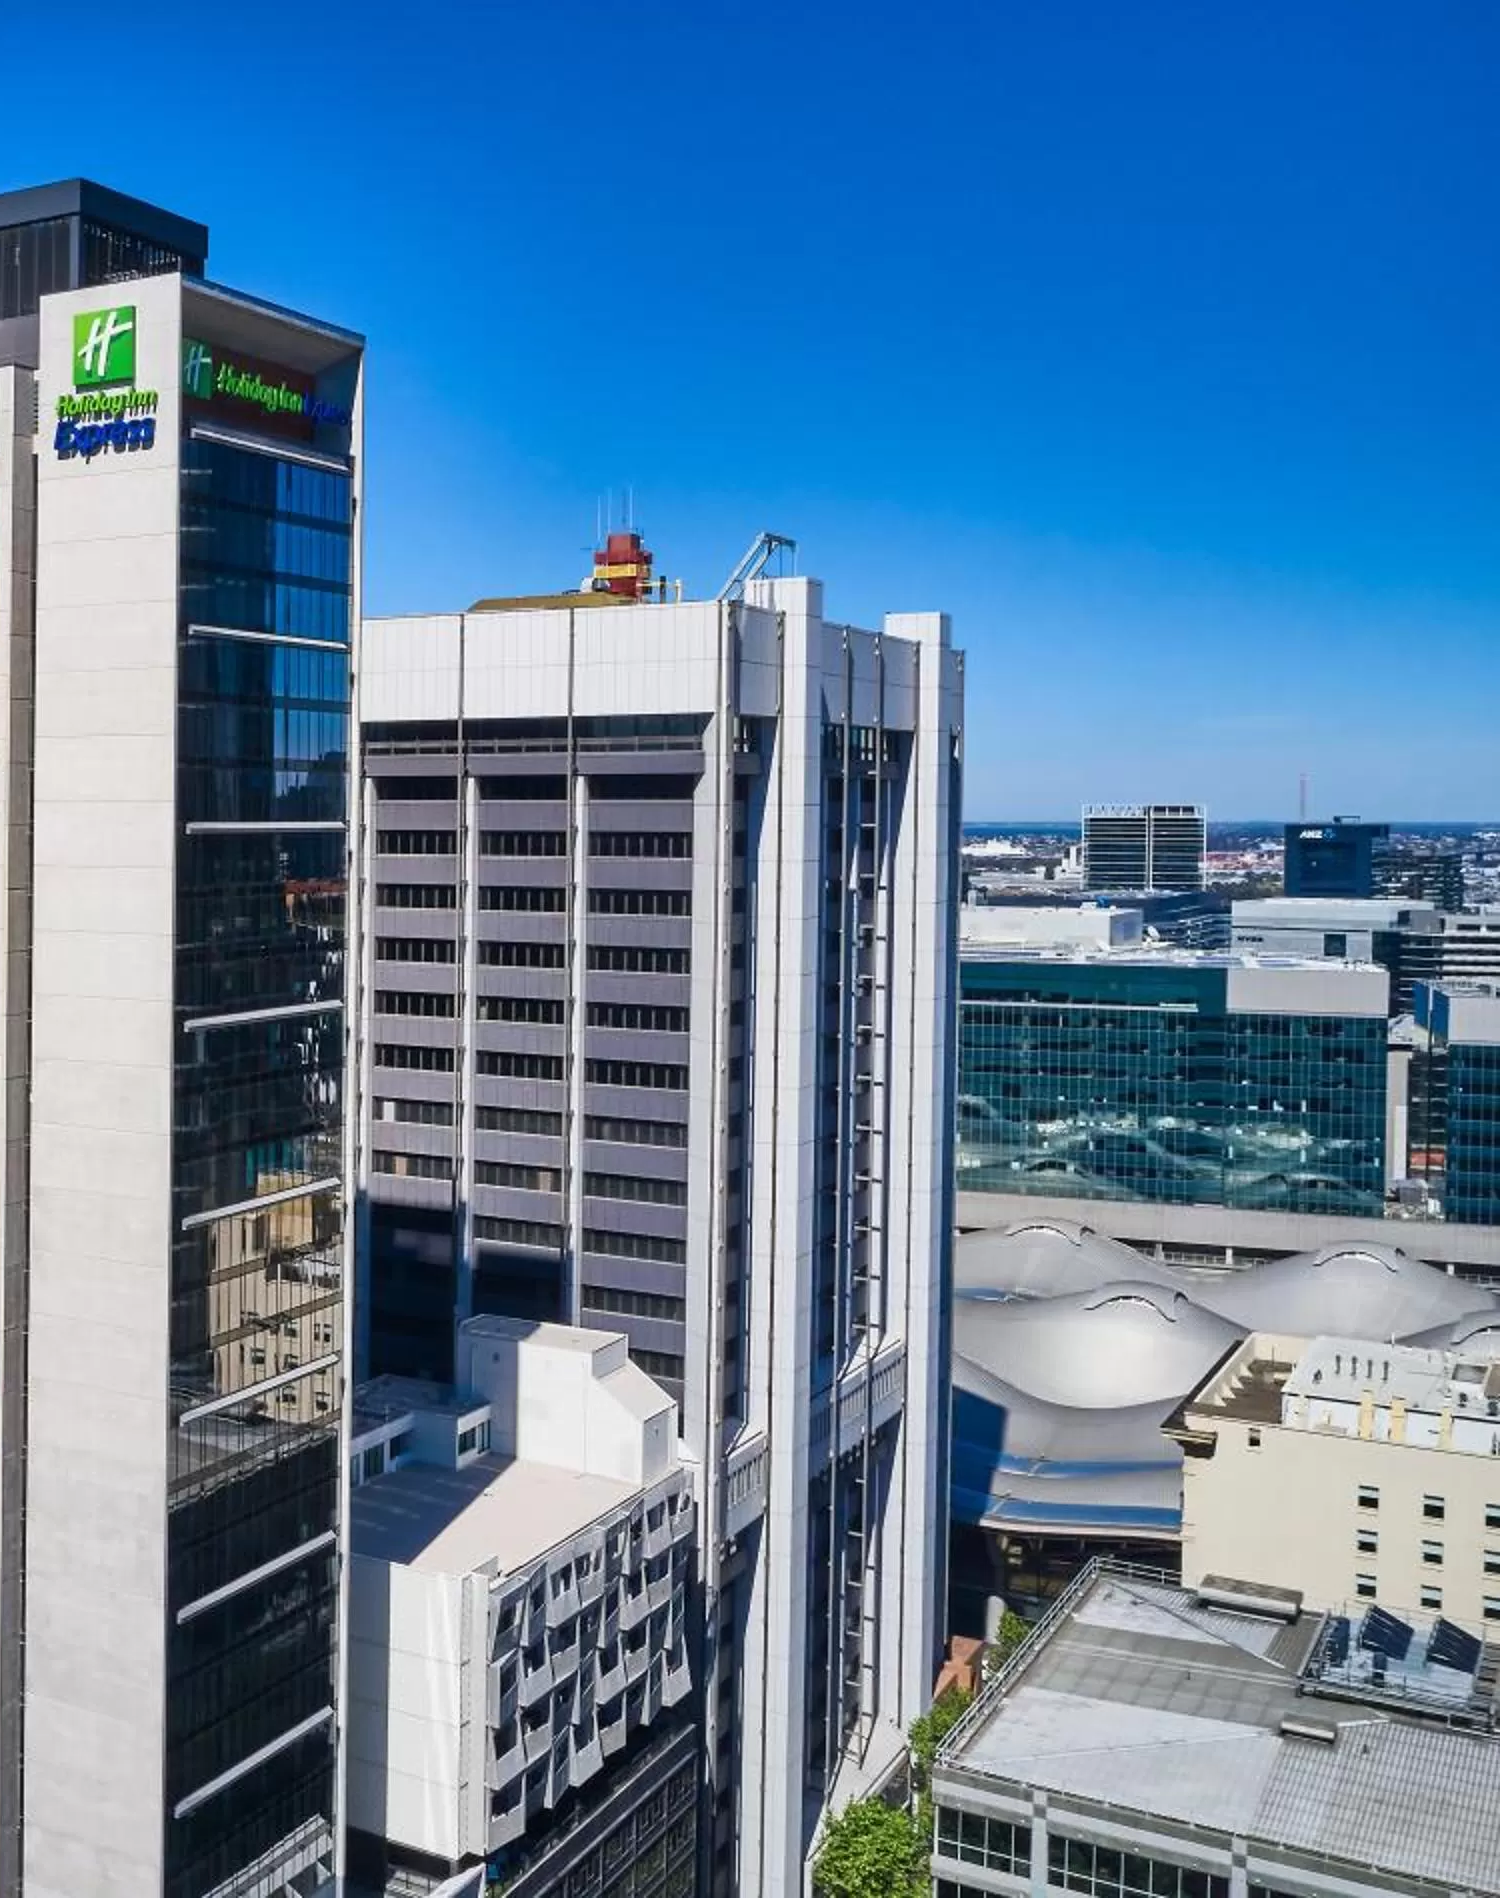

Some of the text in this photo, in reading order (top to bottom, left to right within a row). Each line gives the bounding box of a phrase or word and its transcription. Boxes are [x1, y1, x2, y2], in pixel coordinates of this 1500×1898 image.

[54, 386, 159, 417] Holiday Inn
[216, 361, 278, 414] Holiday
[54, 417, 157, 457] Express
[1299, 829, 1323, 839] ANZ
